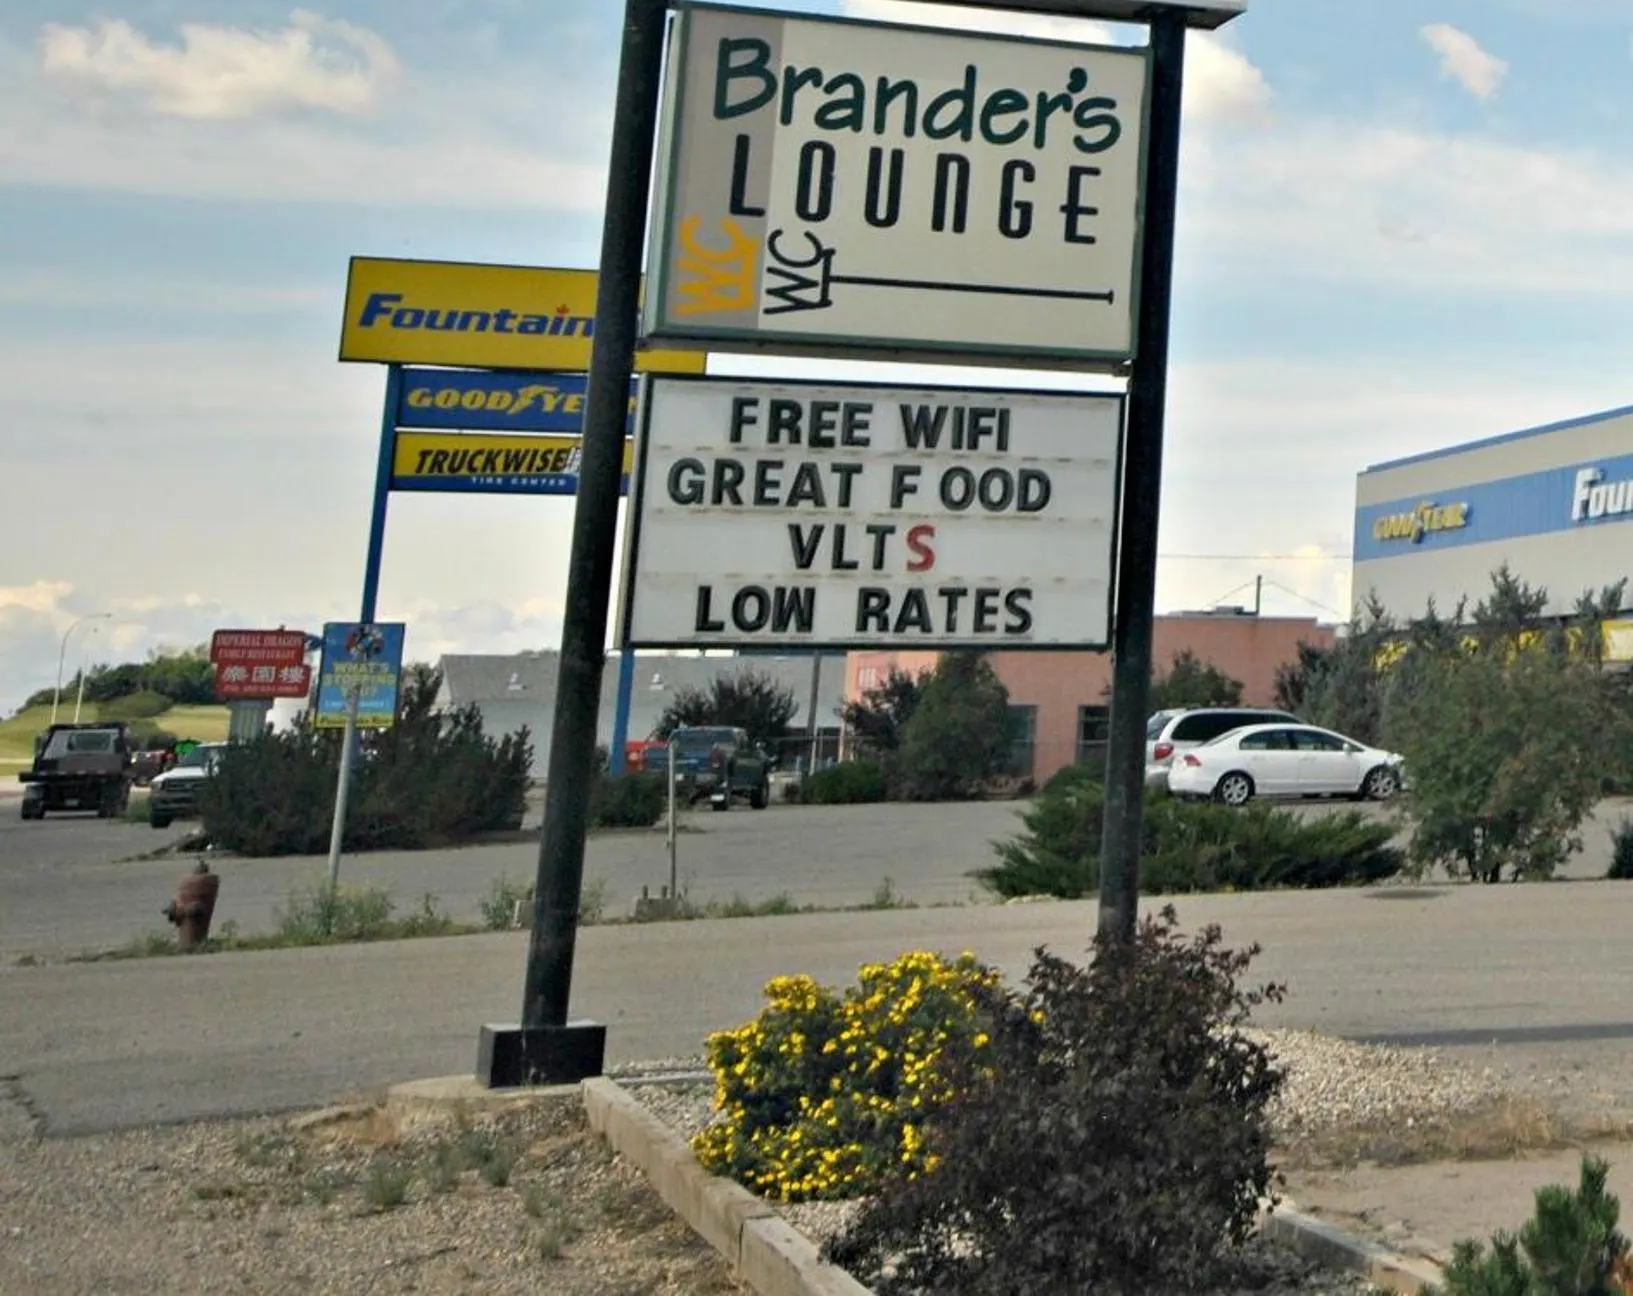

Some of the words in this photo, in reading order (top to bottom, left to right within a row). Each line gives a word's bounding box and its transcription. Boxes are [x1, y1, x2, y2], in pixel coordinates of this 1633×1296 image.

[713, 37, 1121, 153] Brander's
[729, 134, 1101, 244] LOUNGE
[359, 293, 594, 337] Fountain
[407, 384, 637, 415] GOODYE
[729, 396, 873, 448] FREE
[900, 404, 1011, 452] WIFI
[414, 448, 567, 474] TRUCKWISE
[667, 458, 863, 509] GREAT
[890, 465, 1051, 512] FOOD
[787, 524, 937, 572] VLTS
[694, 586, 816, 634] LOW
[855, 587, 1034, 635] RATES
